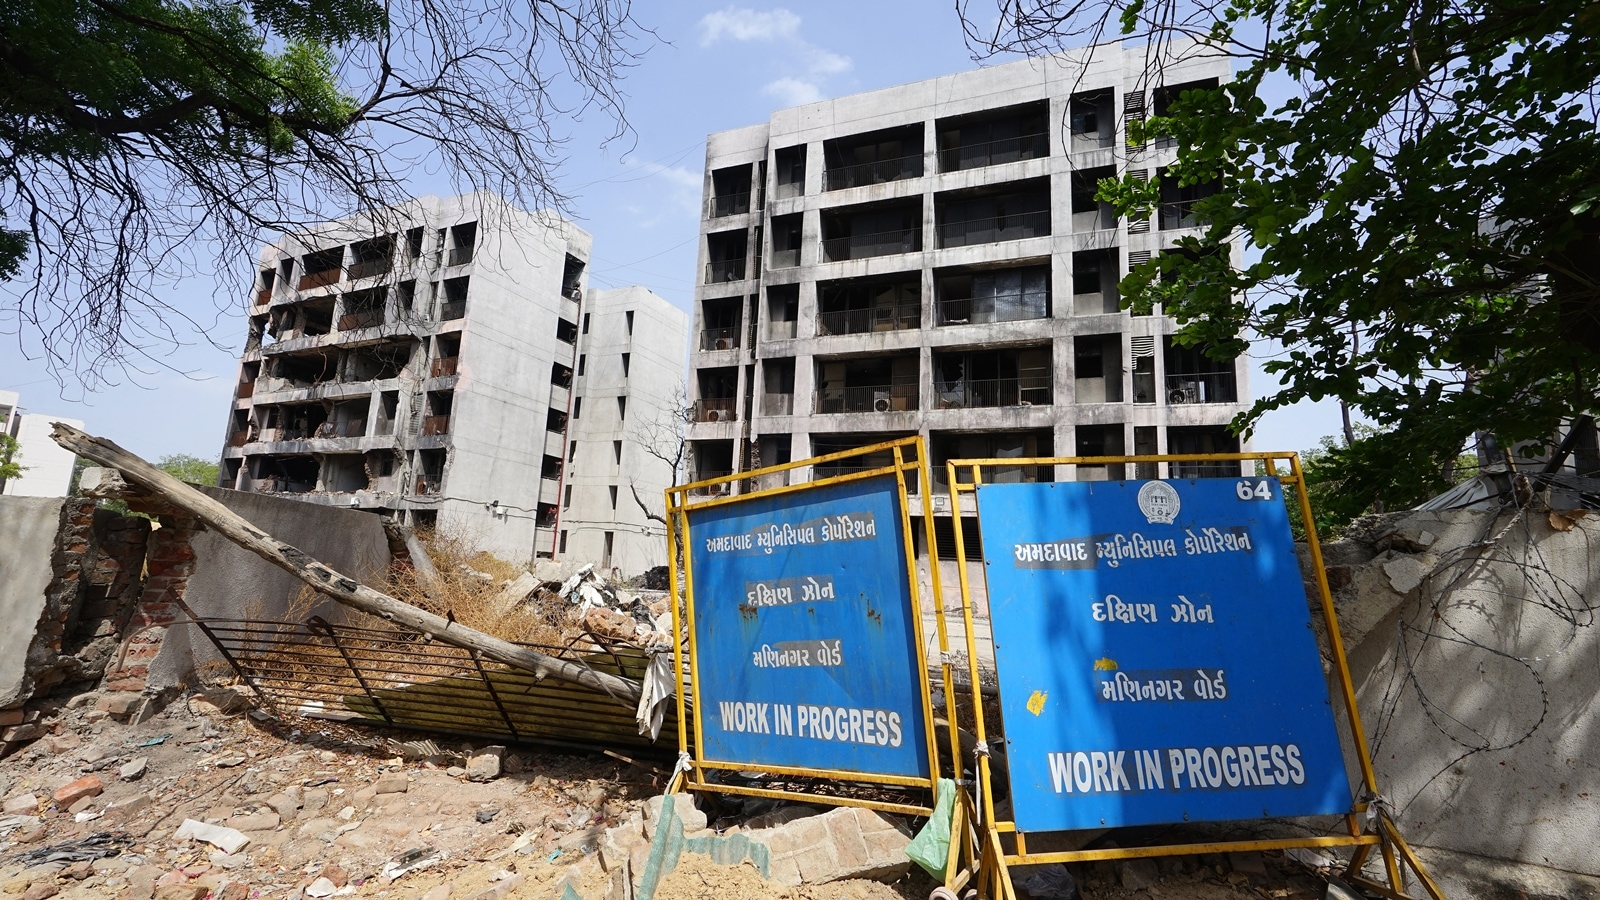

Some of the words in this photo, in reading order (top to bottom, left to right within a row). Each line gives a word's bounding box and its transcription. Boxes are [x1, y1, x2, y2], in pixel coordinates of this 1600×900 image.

[1236, 480, 1272, 500] 64
[706, 533, 752, 553] અમદાવાદ
[757, 523, 815, 555] મ્યુનિસિપલ
[1014, 542, 1088, 563] અમદાવાદ
[1095, 532, 1178, 568] મ્યુનિસિપલ
[747, 583, 793, 607] દક્ષિણ
[801, 576, 835, 602] ઝોન
[1091, 594, 1158, 624] દક્ષિણ
[1170, 595, 1215, 624] ઝોન
[752, 643, 811, 668] મણિનગર
[816, 640, 842, 666] વોર્ડ
[1101, 671, 1185, 702] મણિનગર
[1193, 669, 1227, 700] વોર્ડ
[719, 701, 771, 735] WORK
[774, 703, 793, 737] IN
[797, 704, 903, 748] PROGRESS
[1048, 751, 1131, 794] WORK
[1134, 749, 1165, 790] IN
[1169, 744, 1305, 789] PROGRESS
